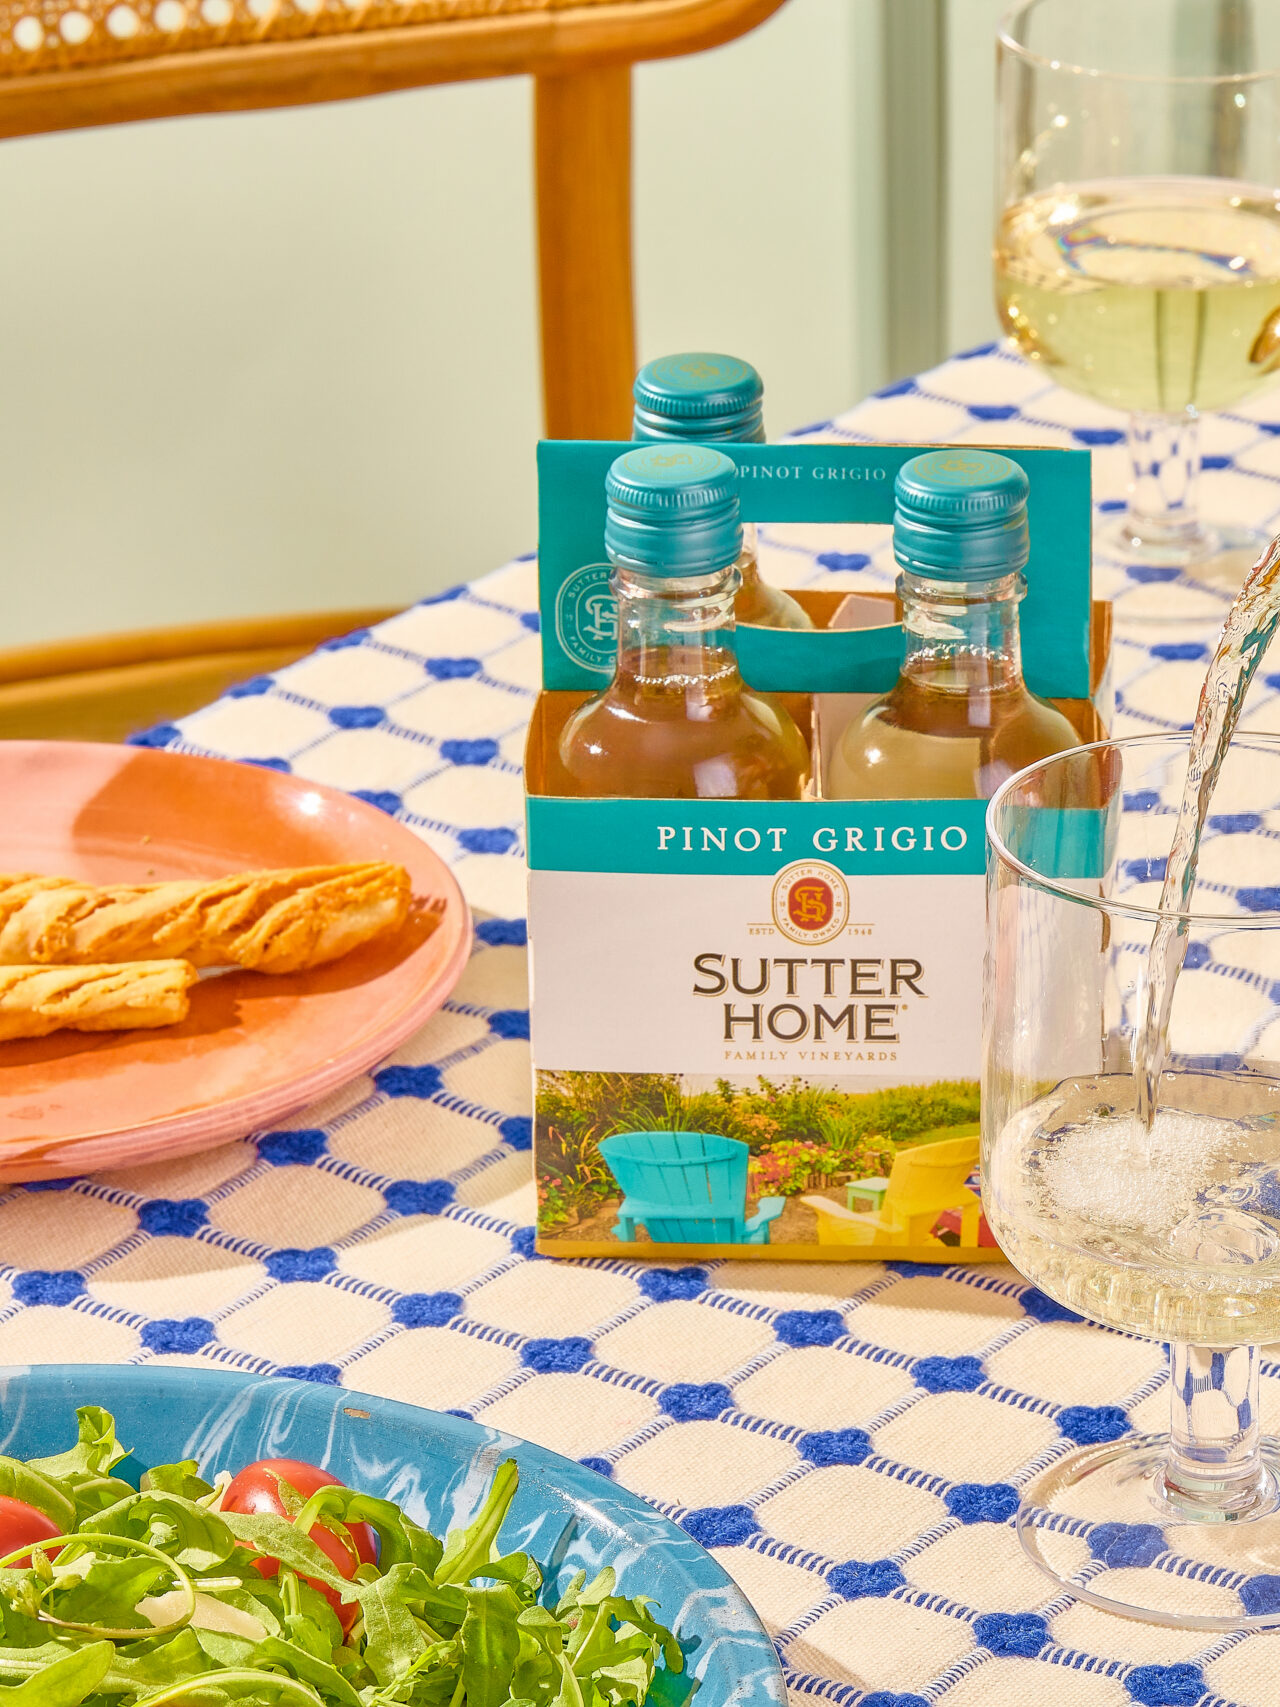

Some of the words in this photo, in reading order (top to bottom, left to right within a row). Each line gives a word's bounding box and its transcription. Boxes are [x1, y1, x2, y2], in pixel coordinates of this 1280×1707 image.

[740, 465, 803, 480] PINOT
[812, 467, 887, 481] GRIGIO
[568, 572, 608, 598] SUTTER
[570, 636, 602, 662] FAMILY
[657, 826, 787, 852] PINOT
[812, 826, 968, 852] GRIGIO
[781, 869, 812, 890] SUTTER
[817, 871, 840, 890] HOME
[782, 917, 809, 938] FAMILY
[812, 918, 840, 939] OWNED
[847, 928, 873, 936] 1948
[693, 952, 929, 998] SUTTER
[722, 1003, 900, 1044] HOME
[725, 1050, 787, 1061] FAMILY
[799, 1051, 897, 1061] VINEYARDS
